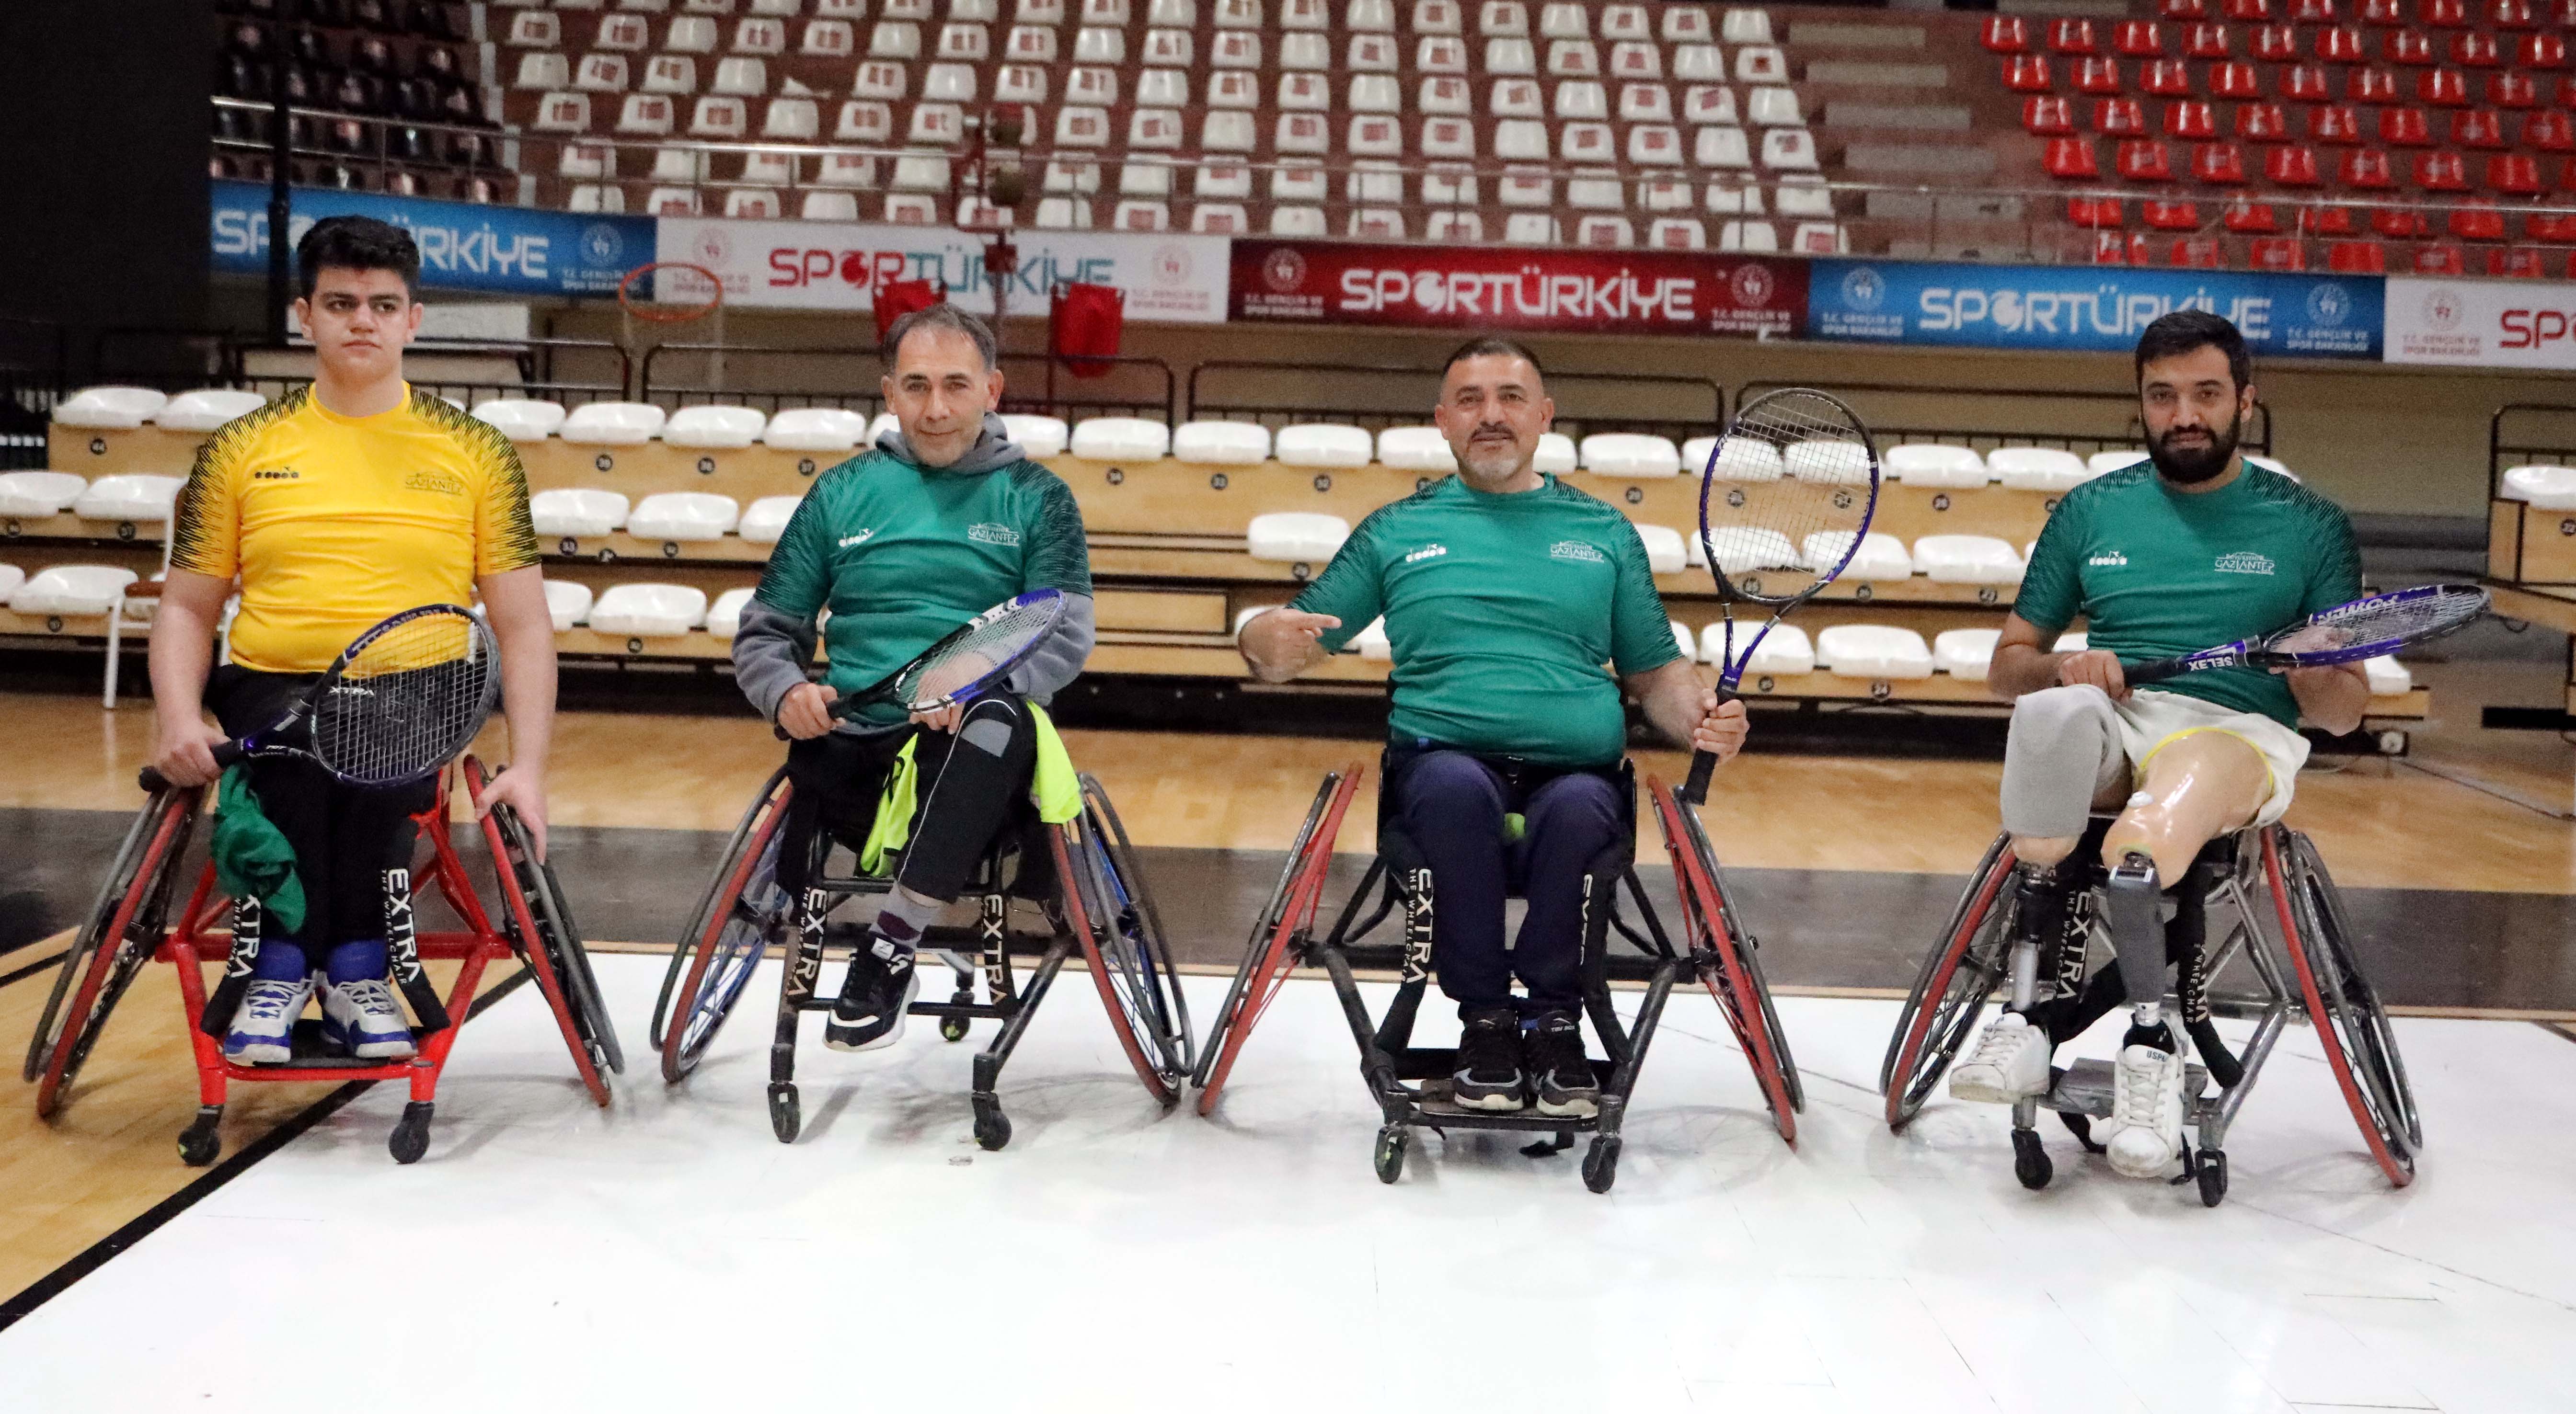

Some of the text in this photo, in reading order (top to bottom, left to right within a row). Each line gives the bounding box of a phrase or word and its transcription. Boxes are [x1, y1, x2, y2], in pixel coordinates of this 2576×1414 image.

[1341, 266, 1695, 320] SPORTÜRKİYE
[2500, 309, 2576, 350] SP
[230, 894, 261, 978] XTRA
[388, 868, 421, 982] EXTRA
[787, 889, 828, 995] EXTRA
[983, 894, 1008, 1005] EXTRA
[1406, 868, 1433, 983] EXTRA
[2057, 891, 2092, 999] EXTRA
